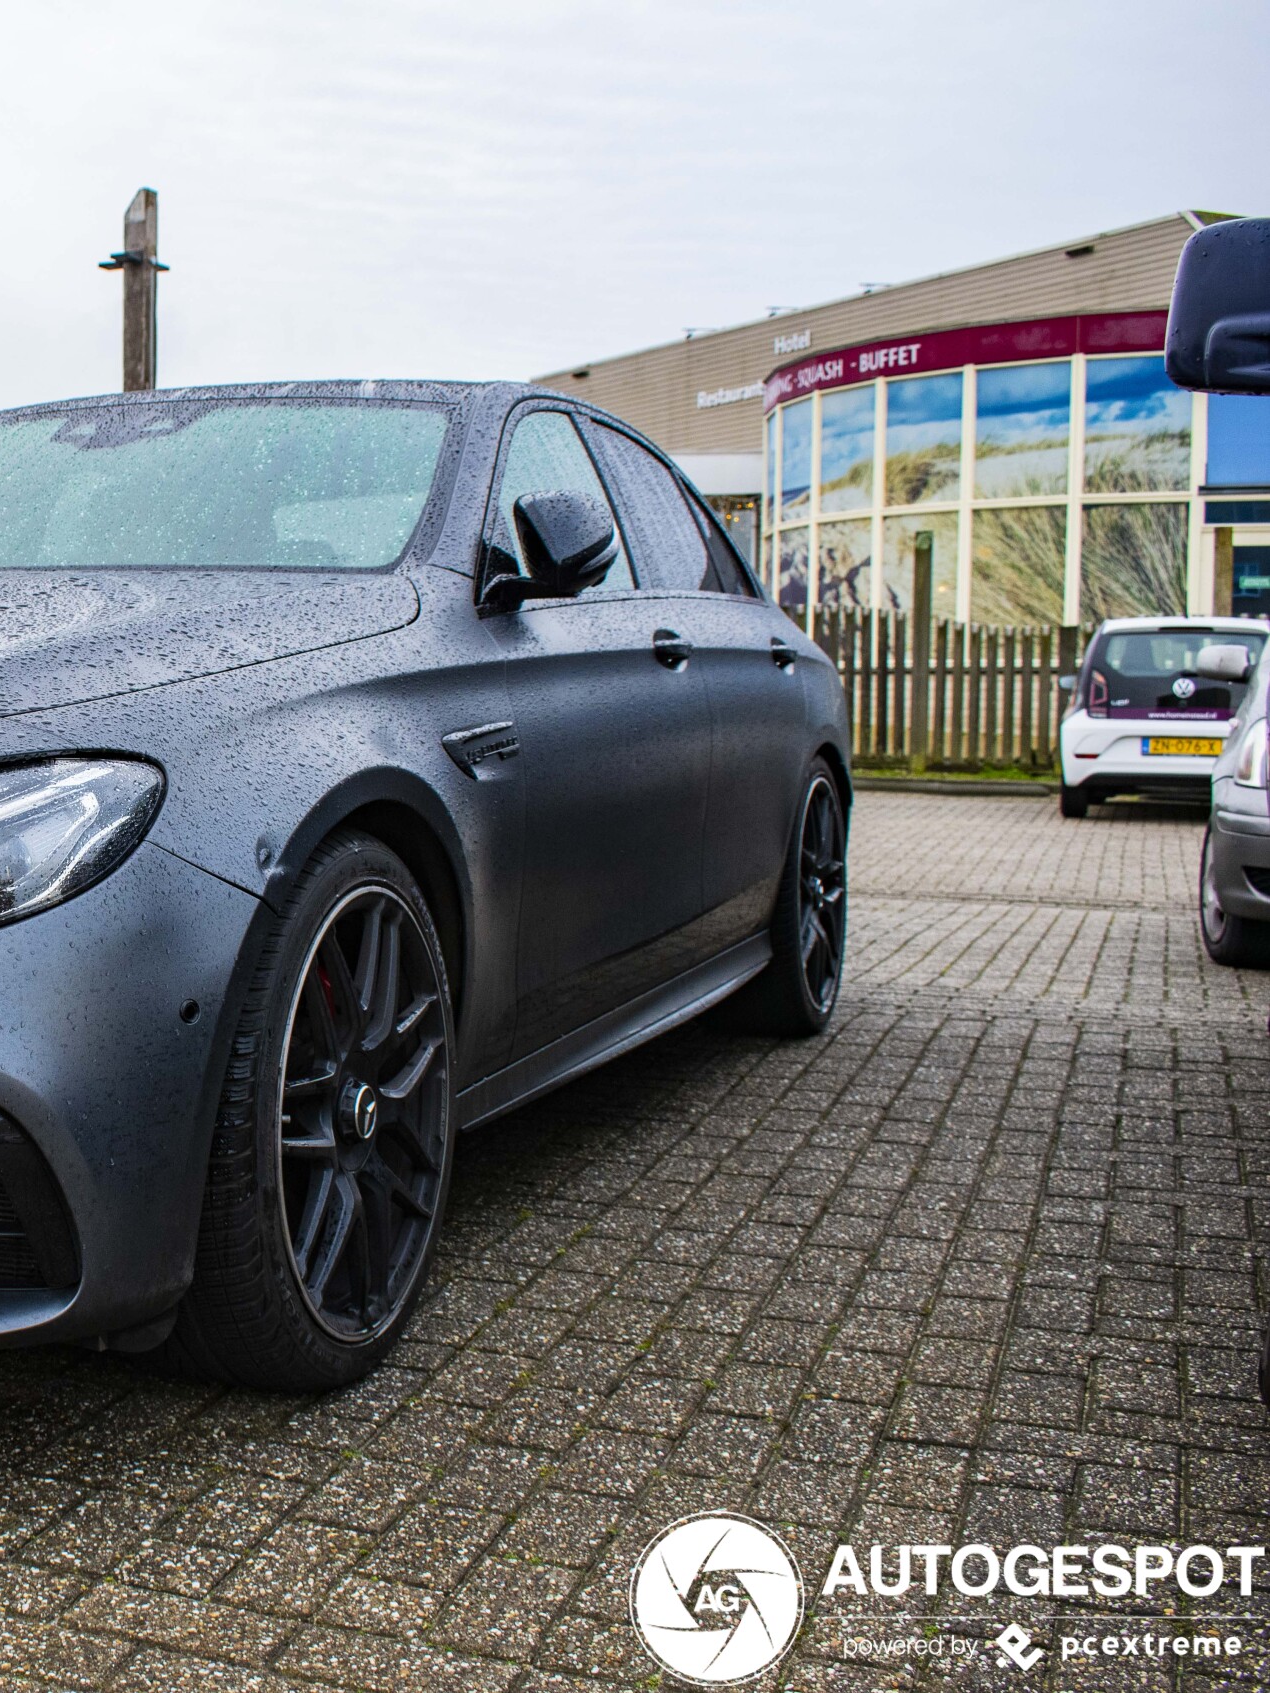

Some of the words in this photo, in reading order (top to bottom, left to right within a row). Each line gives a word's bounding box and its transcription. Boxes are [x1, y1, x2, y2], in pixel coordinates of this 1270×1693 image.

[774, 330, 811, 354] Hotel
[798, 360, 843, 388] SQUASH
[859, 344, 921, 372] BUFFET
[1153, 738, 1215, 753] ZN-076-X
